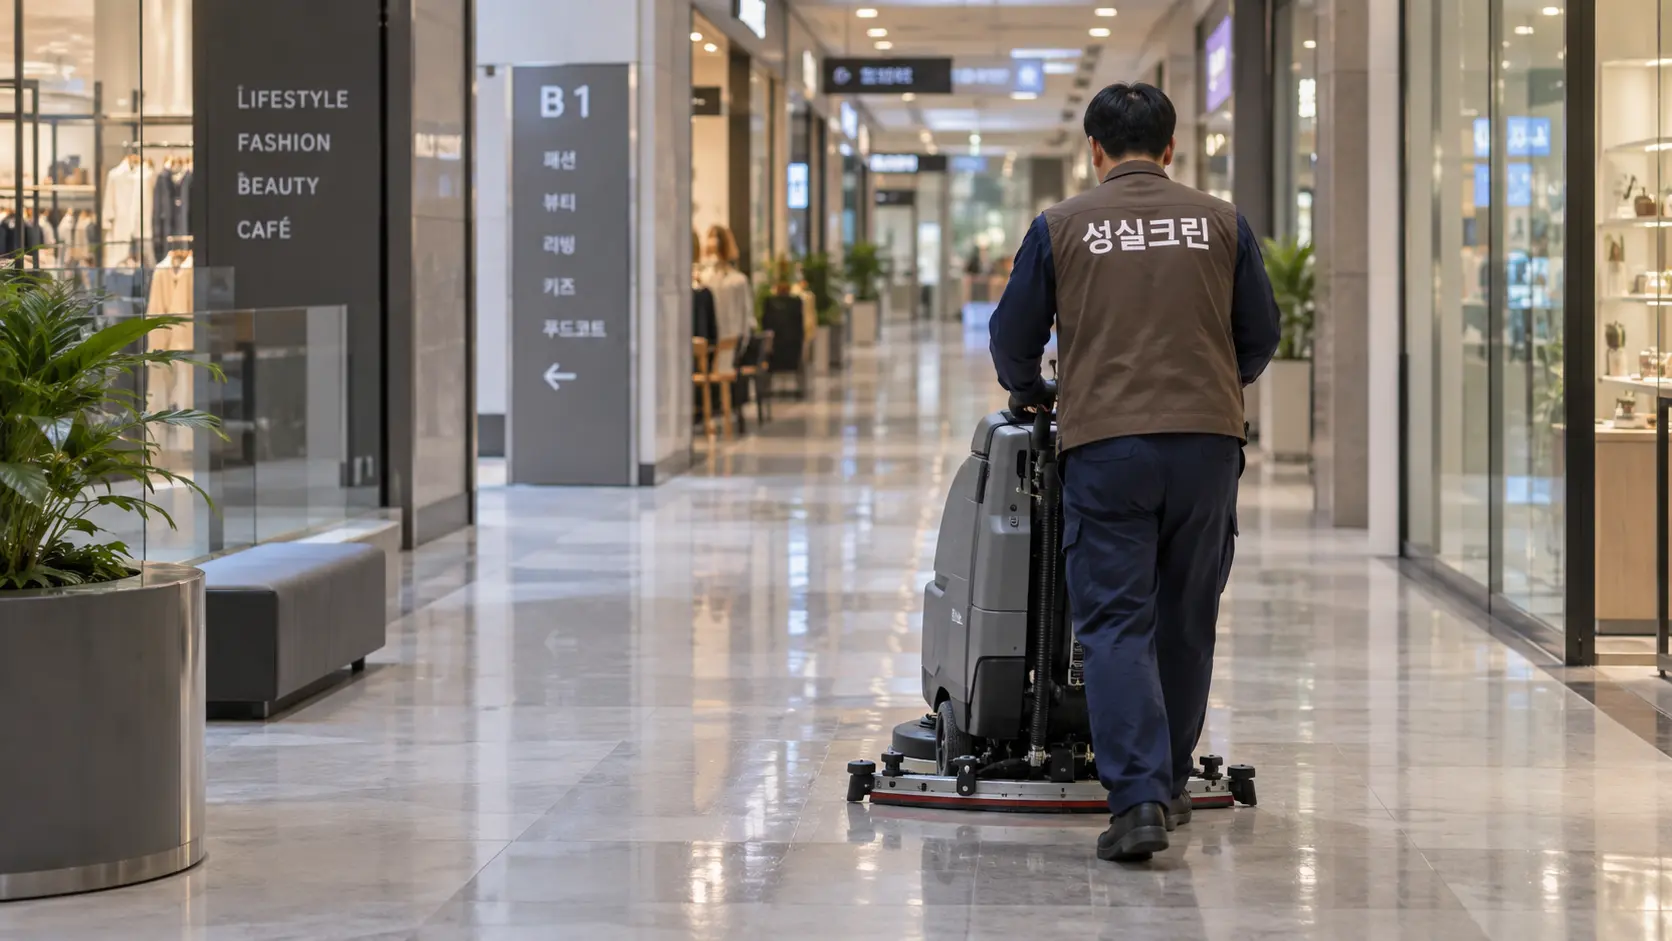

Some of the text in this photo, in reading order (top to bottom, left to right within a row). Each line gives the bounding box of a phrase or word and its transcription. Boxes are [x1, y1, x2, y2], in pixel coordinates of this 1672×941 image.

[237, 88, 349, 110] LIFESTYLE
[237, 132, 331, 153] FASHION
[543, 150, 576, 170] 패션
[237, 176, 320, 196] BEAUTY
[543, 193, 576, 212] 뷰티
[236, 216, 292, 239] CAFÉ
[1082, 217, 1210, 254] 성실크린
[543, 234, 576, 255] 리빙
[543, 277, 576, 297] 키즈
